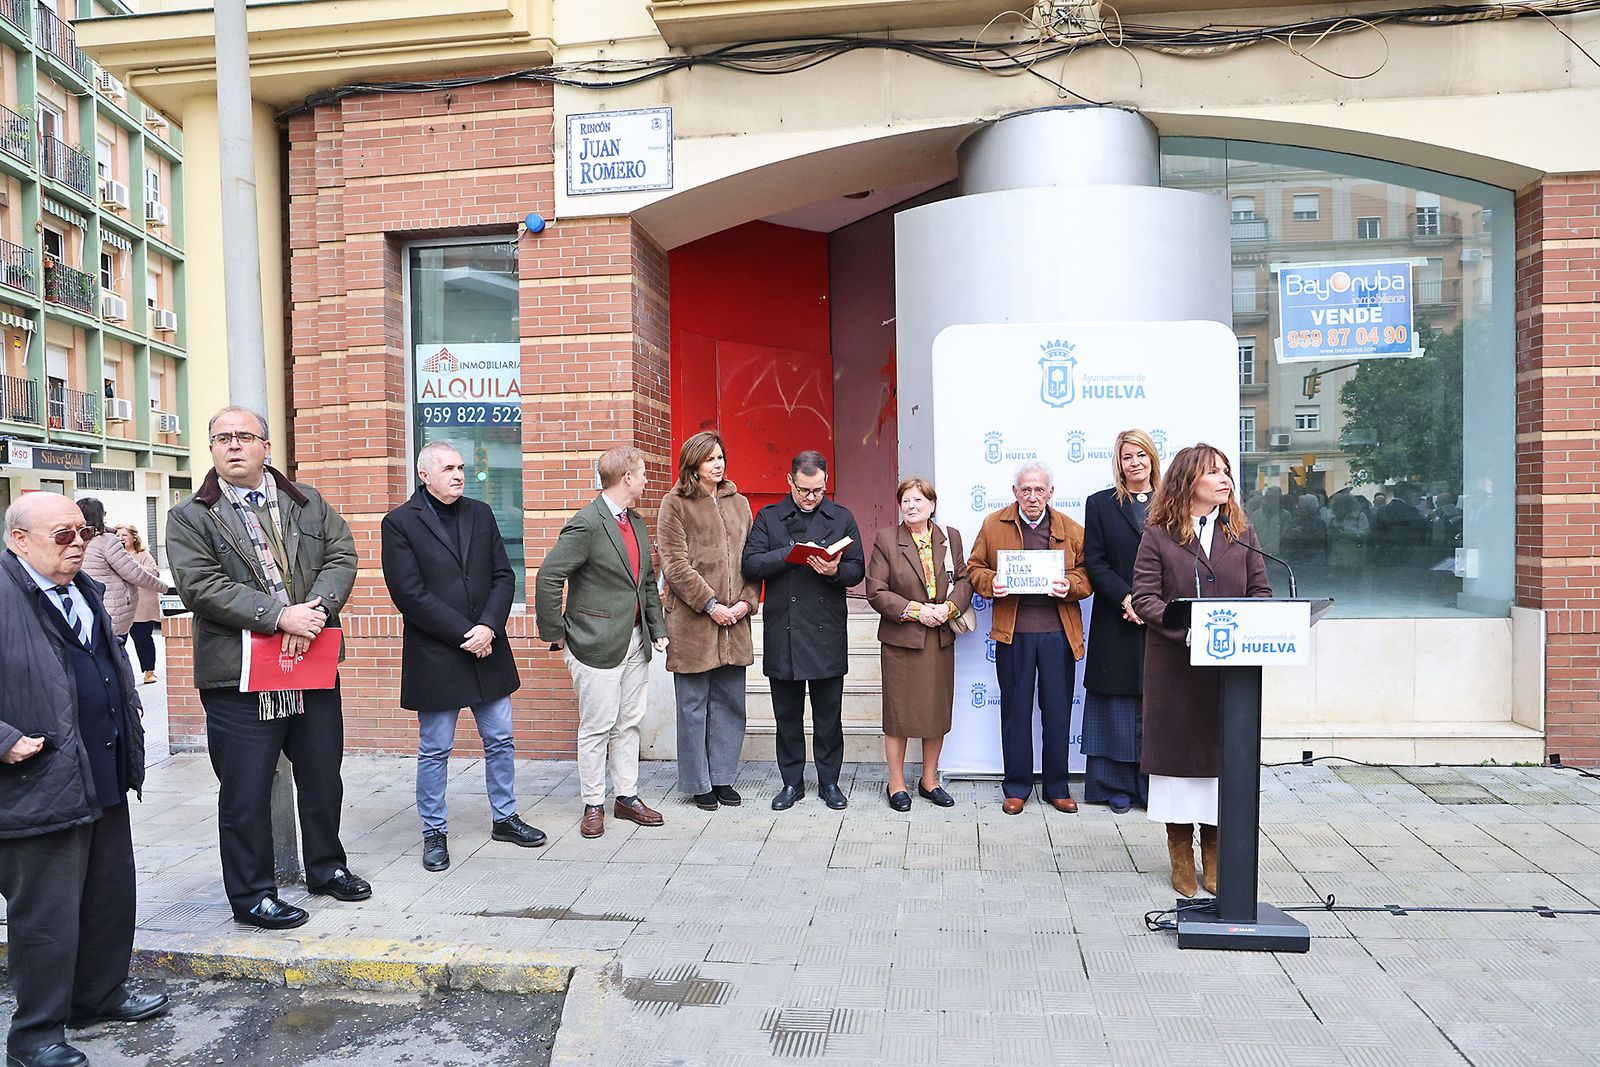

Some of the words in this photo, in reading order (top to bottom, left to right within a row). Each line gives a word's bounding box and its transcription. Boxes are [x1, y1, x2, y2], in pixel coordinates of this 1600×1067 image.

[580, 121, 611, 135] RINCÓN
[580, 138, 621, 160] JUAN
[580, 160, 647, 184] ROMERO
[1310, 307, 1383, 326] VENDE
[1287, 329, 1322, 348] 959
[1327, 328, 1350, 346] 87
[1356, 327, 1379, 345] 04
[1384, 325, 1407, 344] 90
[1082, 374, 1135, 383] Ayuntamiento
[1136, 374, 1147, 382] de
[422, 378, 522, 400] ALQUILA
[1082, 385, 1146, 399] HUELVA
[424, 407, 452, 423] 959
[457, 406, 486, 423] 822
[492, 406, 522, 422] 522
[1005, 452, 1037, 460] HUELVA
[1087, 451, 1114, 459] HUELV
[1006, 563, 1032, 575] JUAN
[1006, 576, 1049, 588] ROMERO
[1242, 642, 1296, 653] HUELVA
